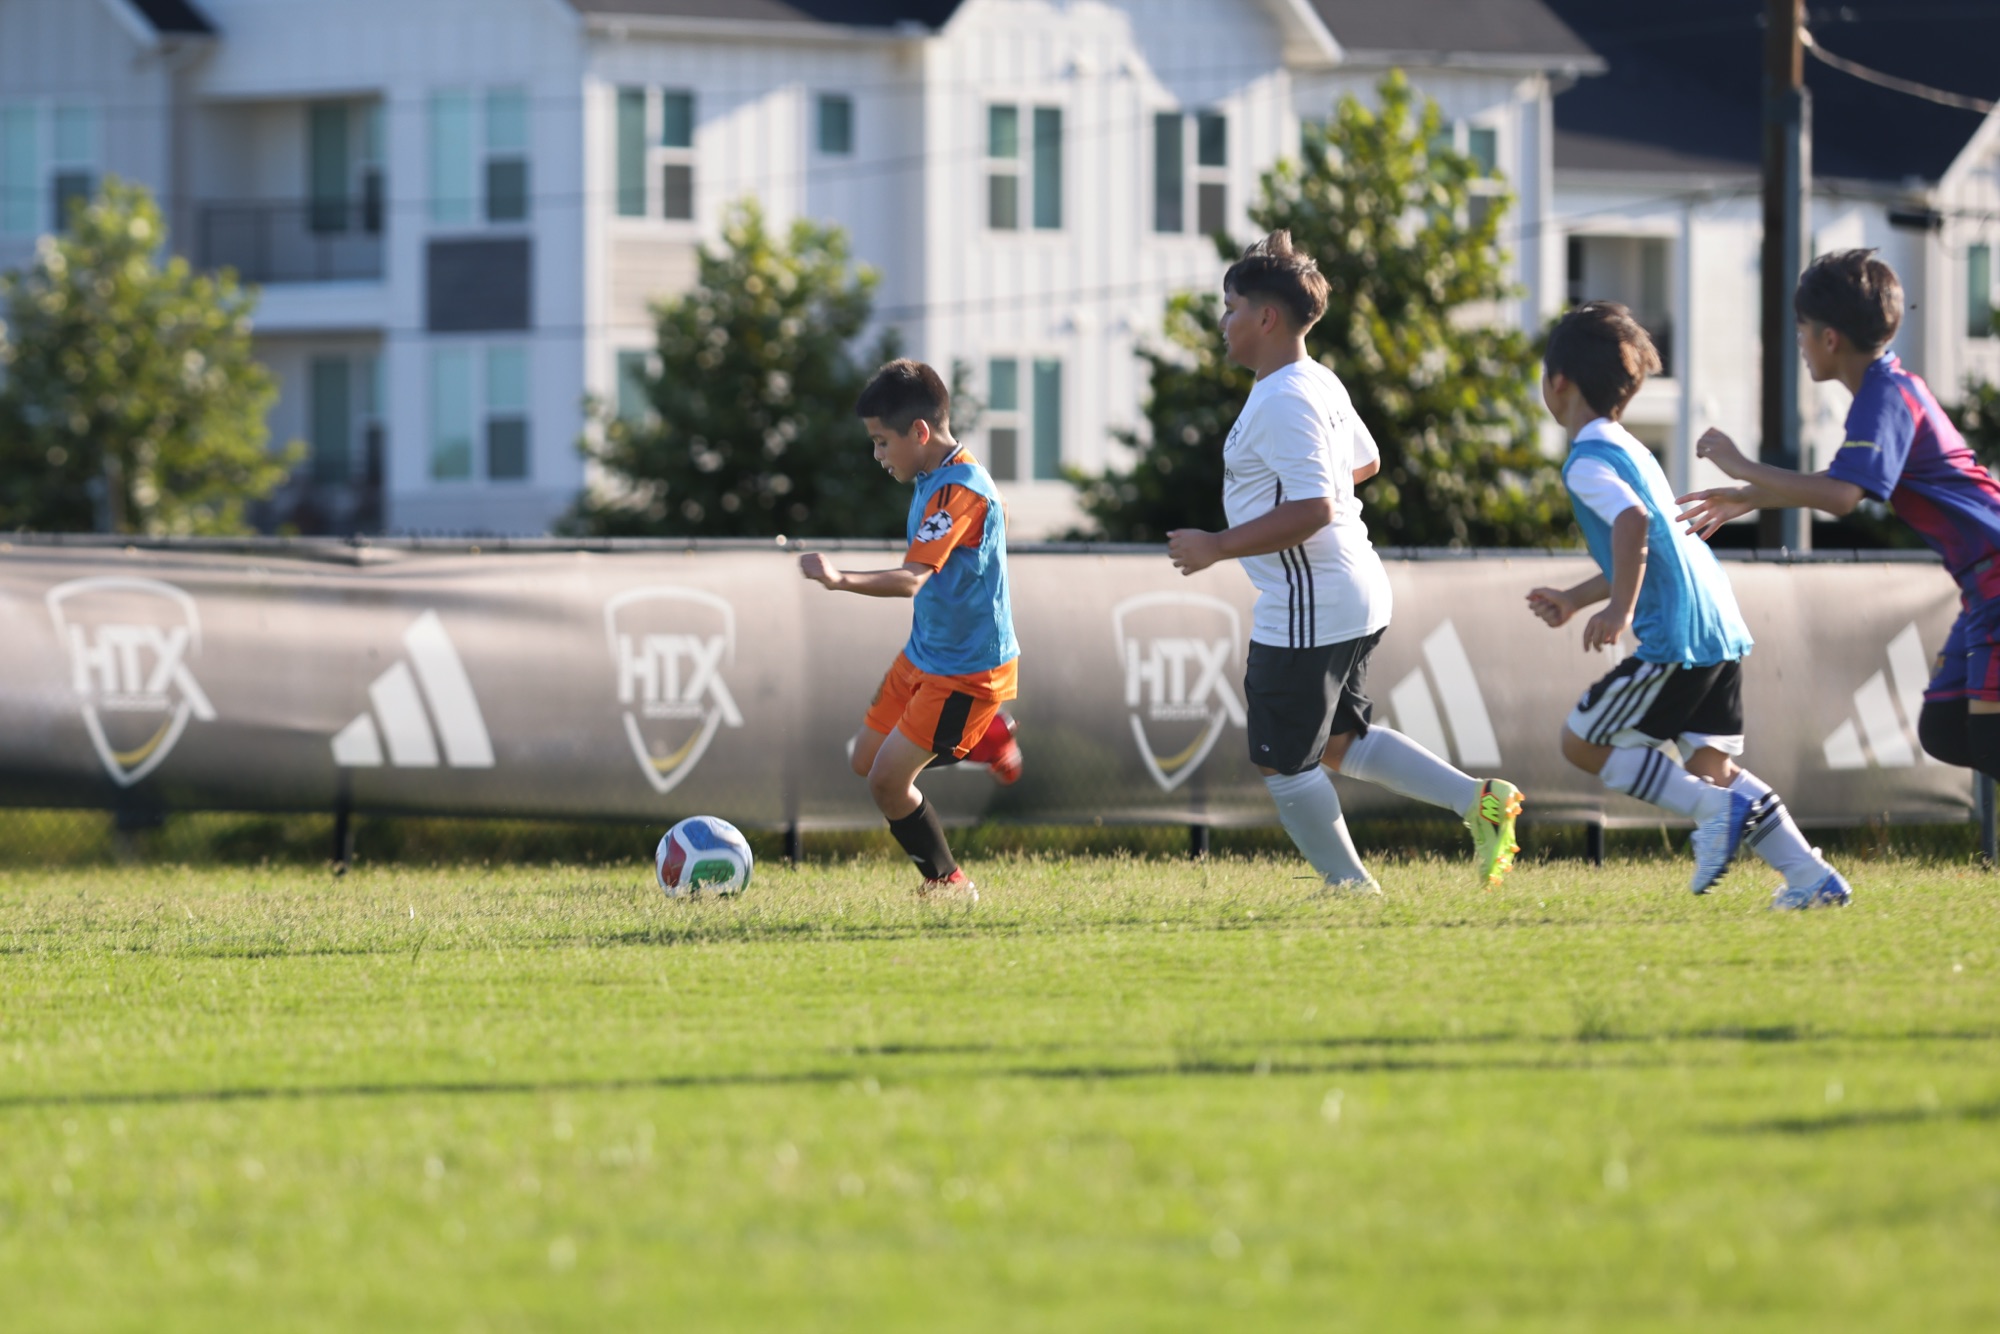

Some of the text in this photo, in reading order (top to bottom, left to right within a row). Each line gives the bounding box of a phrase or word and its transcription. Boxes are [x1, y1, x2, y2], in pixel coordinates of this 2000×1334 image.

[70, 623, 216, 721] HTX
[618, 633, 743, 727] HTX
[1126, 638, 1248, 728] HTX
